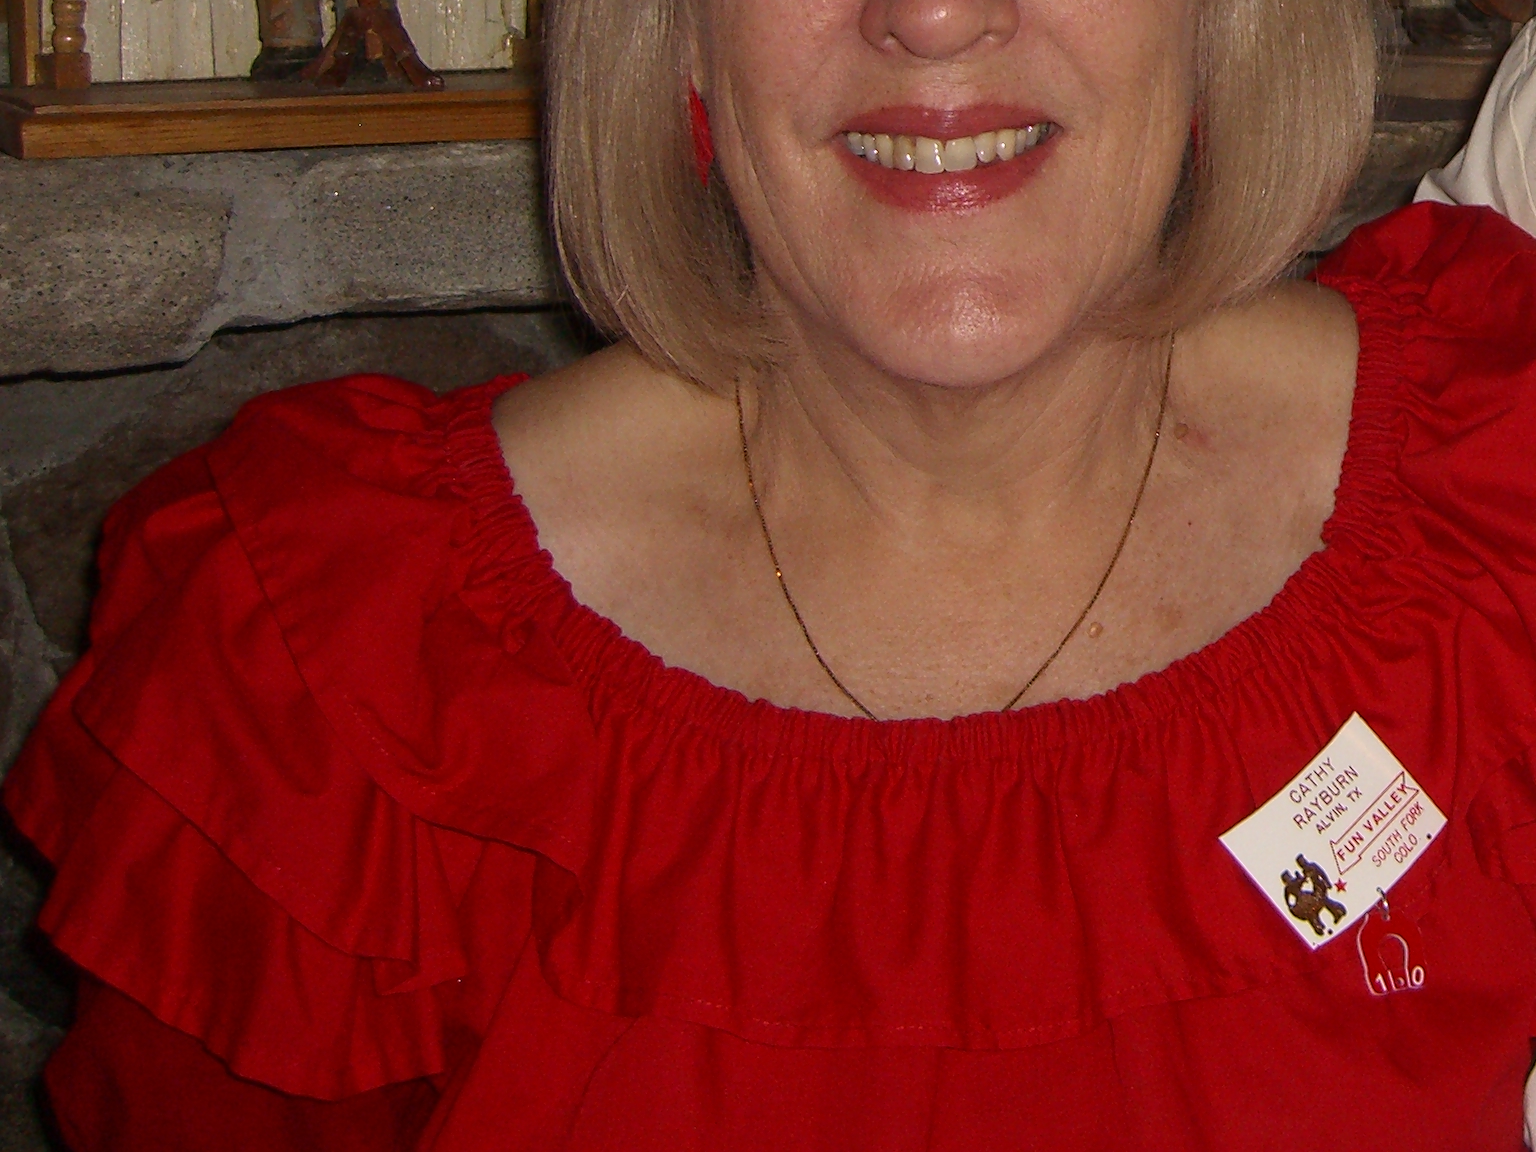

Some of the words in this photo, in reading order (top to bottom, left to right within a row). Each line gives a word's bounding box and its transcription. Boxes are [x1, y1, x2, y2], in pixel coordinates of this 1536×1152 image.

[1289, 757, 1335, 803] CATHY
[1293, 765, 1359, 830] RAYBURN
[1346, 787, 1362, 803] TX
[1337, 831, 1364, 861] FUN
[1362, 783, 1408, 832] VALLEY
[1372, 829, 1402, 867] SOUTH
[1401, 801, 1424, 831] FORK
